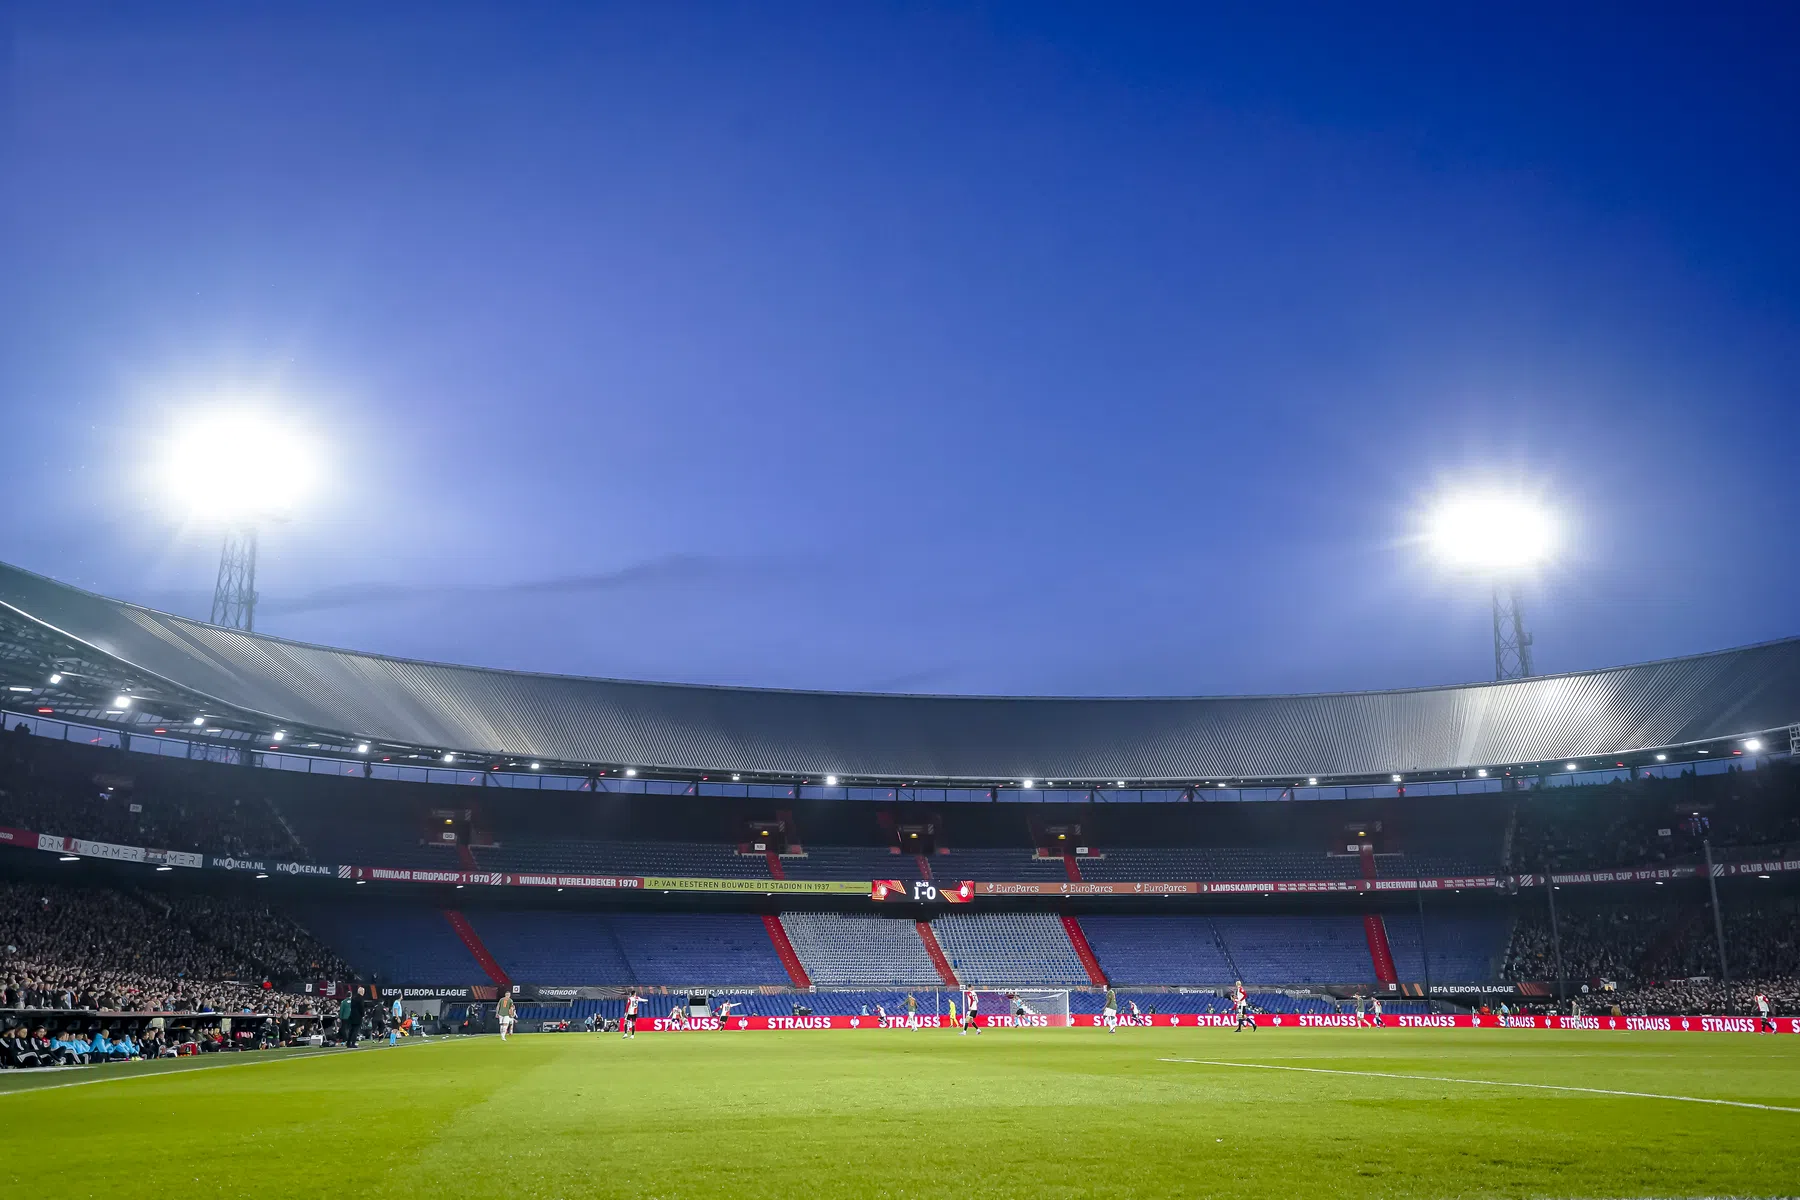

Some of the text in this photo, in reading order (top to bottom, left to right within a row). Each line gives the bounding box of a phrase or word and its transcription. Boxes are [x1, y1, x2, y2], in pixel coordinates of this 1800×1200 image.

[213, 857, 266, 870] KNAKEN.NL
[276, 862, 331, 875] KNAKEN.NL
[1741, 863, 1762, 873] CLUB
[1764, 862, 1782, 872] VAN
[372, 869, 489, 883] WINNAAR EUROPACUP 1 1970
[519, 876, 638, 887] WINNAAR WERELDBEKER 1970
[1552, 874, 1591, 884] WINNAAR
[1593, 873, 1614, 882] UEFA
[1616, 872, 1633, 881] CUP
[1635, 870, 1656, 879] 1974
[1658, 869, 1670, 878] EN
[996, 884, 1040, 893] EuroParcs
[1070, 884, 1113, 893] EuroParcs
[1144, 883, 1187, 892] EuroParcs
[1211, 883, 1274, 892] LANDSKAMPIOEN
[382, 988, 402, 996] UEFA
[404, 989, 434, 997] EUROPA
[1450, 986, 1480, 994] EUROPA
[1482, 985, 1513, 993] LEAGUE
[767, 1017, 831, 1029] STRAUSS
[1197, 1016, 1255, 1027] STRAUS
[1299, 1016, 1356, 1027] STRAUSS
[1399, 1016, 1455, 1027] STRAUSS
[1626, 1018, 1671, 1030] STRAUSS
[1702, 1018, 1755, 1032] STRAUSS
